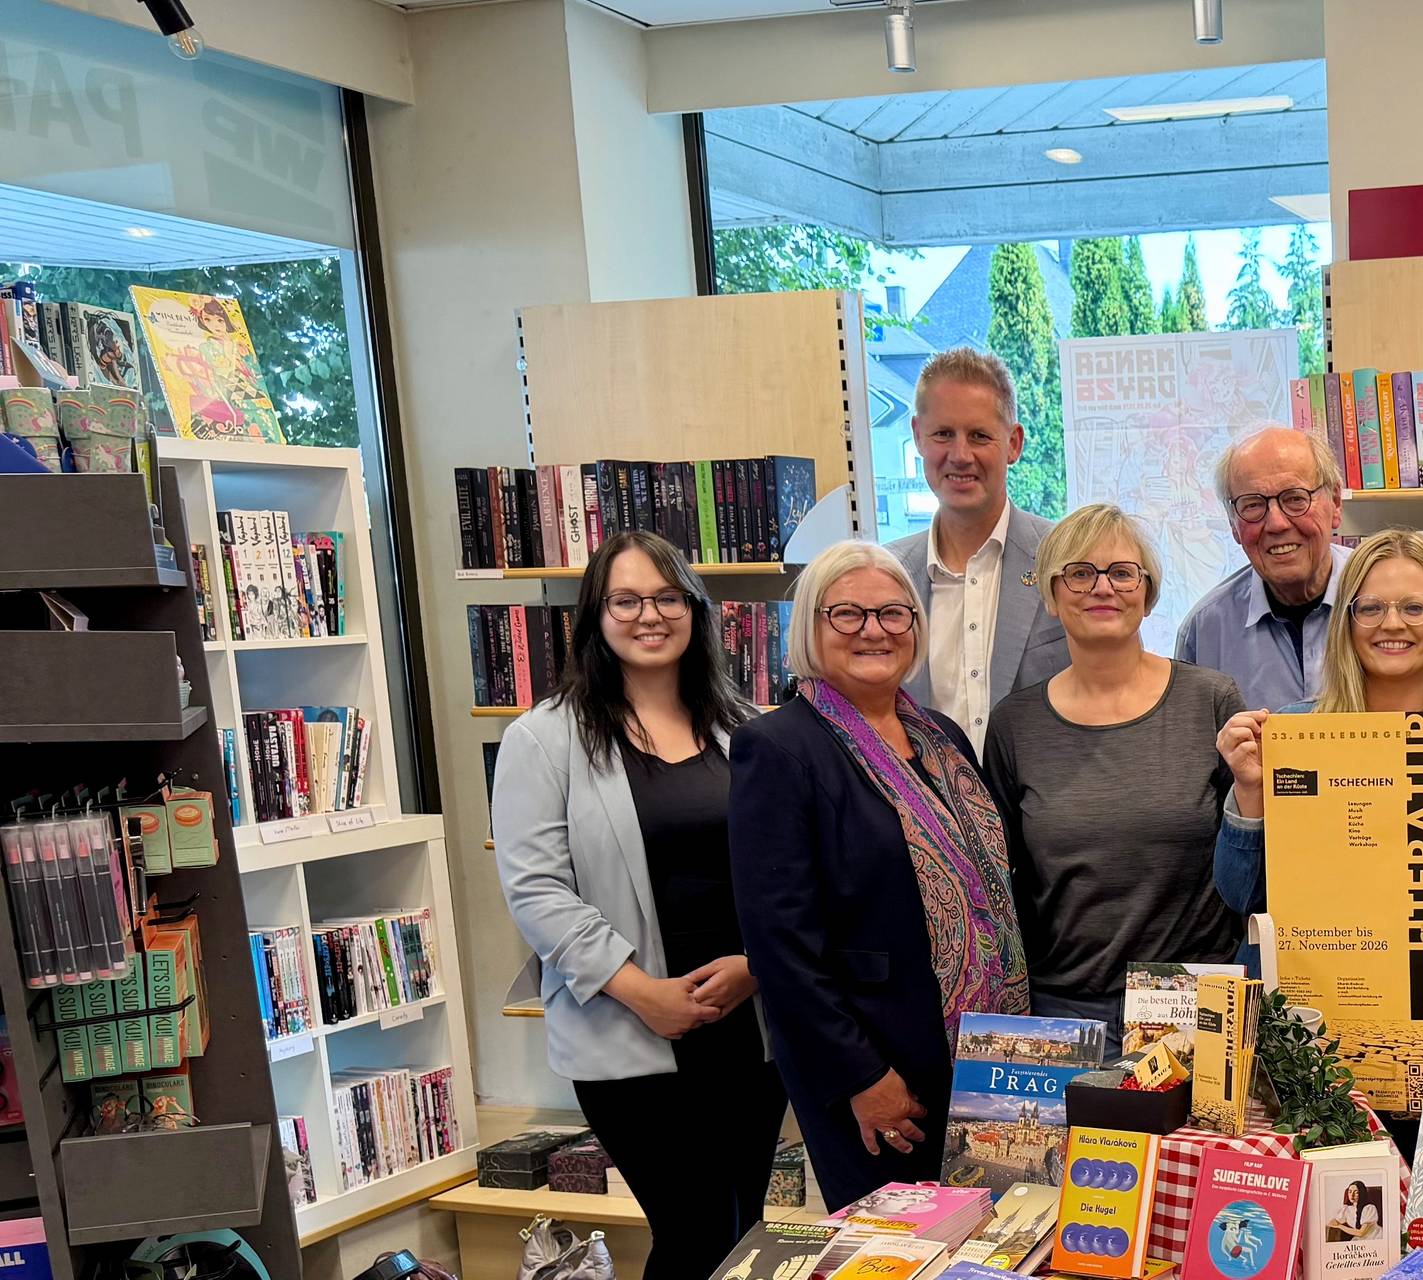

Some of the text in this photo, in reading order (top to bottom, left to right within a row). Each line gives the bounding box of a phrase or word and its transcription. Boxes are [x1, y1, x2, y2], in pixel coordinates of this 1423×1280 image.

[583, 473, 599, 512] CORRUPT
[458, 484, 473, 531] EVIL ELITE
[568, 503, 581, 544] GHOST
[269, 724, 281, 768] BASTARD
[1271, 730, 1413, 740] 33. BERLEBURGER
[1328, 777, 1394, 787] TSCHECHIEN
[1278, 926, 1373, 939] 3. September bis
[1278, 940, 1388, 951] 27. November 2026
[152, 953, 174, 1038] LET'S SUDKU!!
[1150, 995, 1179, 1005] besten
[58, 997, 82, 1051] SUDKU!!
[90, 991, 113, 1046] SUDKU!!
[122, 987, 144, 1041] SUDKU!!
[73, 1050, 86, 1077] VINTAGE
[104, 1045, 116, 1071] VINTAGE
[134, 1041, 145, 1068] VINTAGE
[164, 1038, 175, 1064] VINTAGE
[145, 1079, 186, 1090] BINOCULARS
[989, 1066, 1058, 1093] PRAG
[1212, 1168, 1290, 1192] SUDETENLOVE
[1080, 1201, 1117, 1216] Die Kugel
[766, 1223, 836, 1233] BRAUEREIEN
[857, 1258, 899, 1274] Bier
[1325, 1258, 1385, 1270] Geteiltes Haus
[1332, 1250, 1378, 1261] Horáčková
